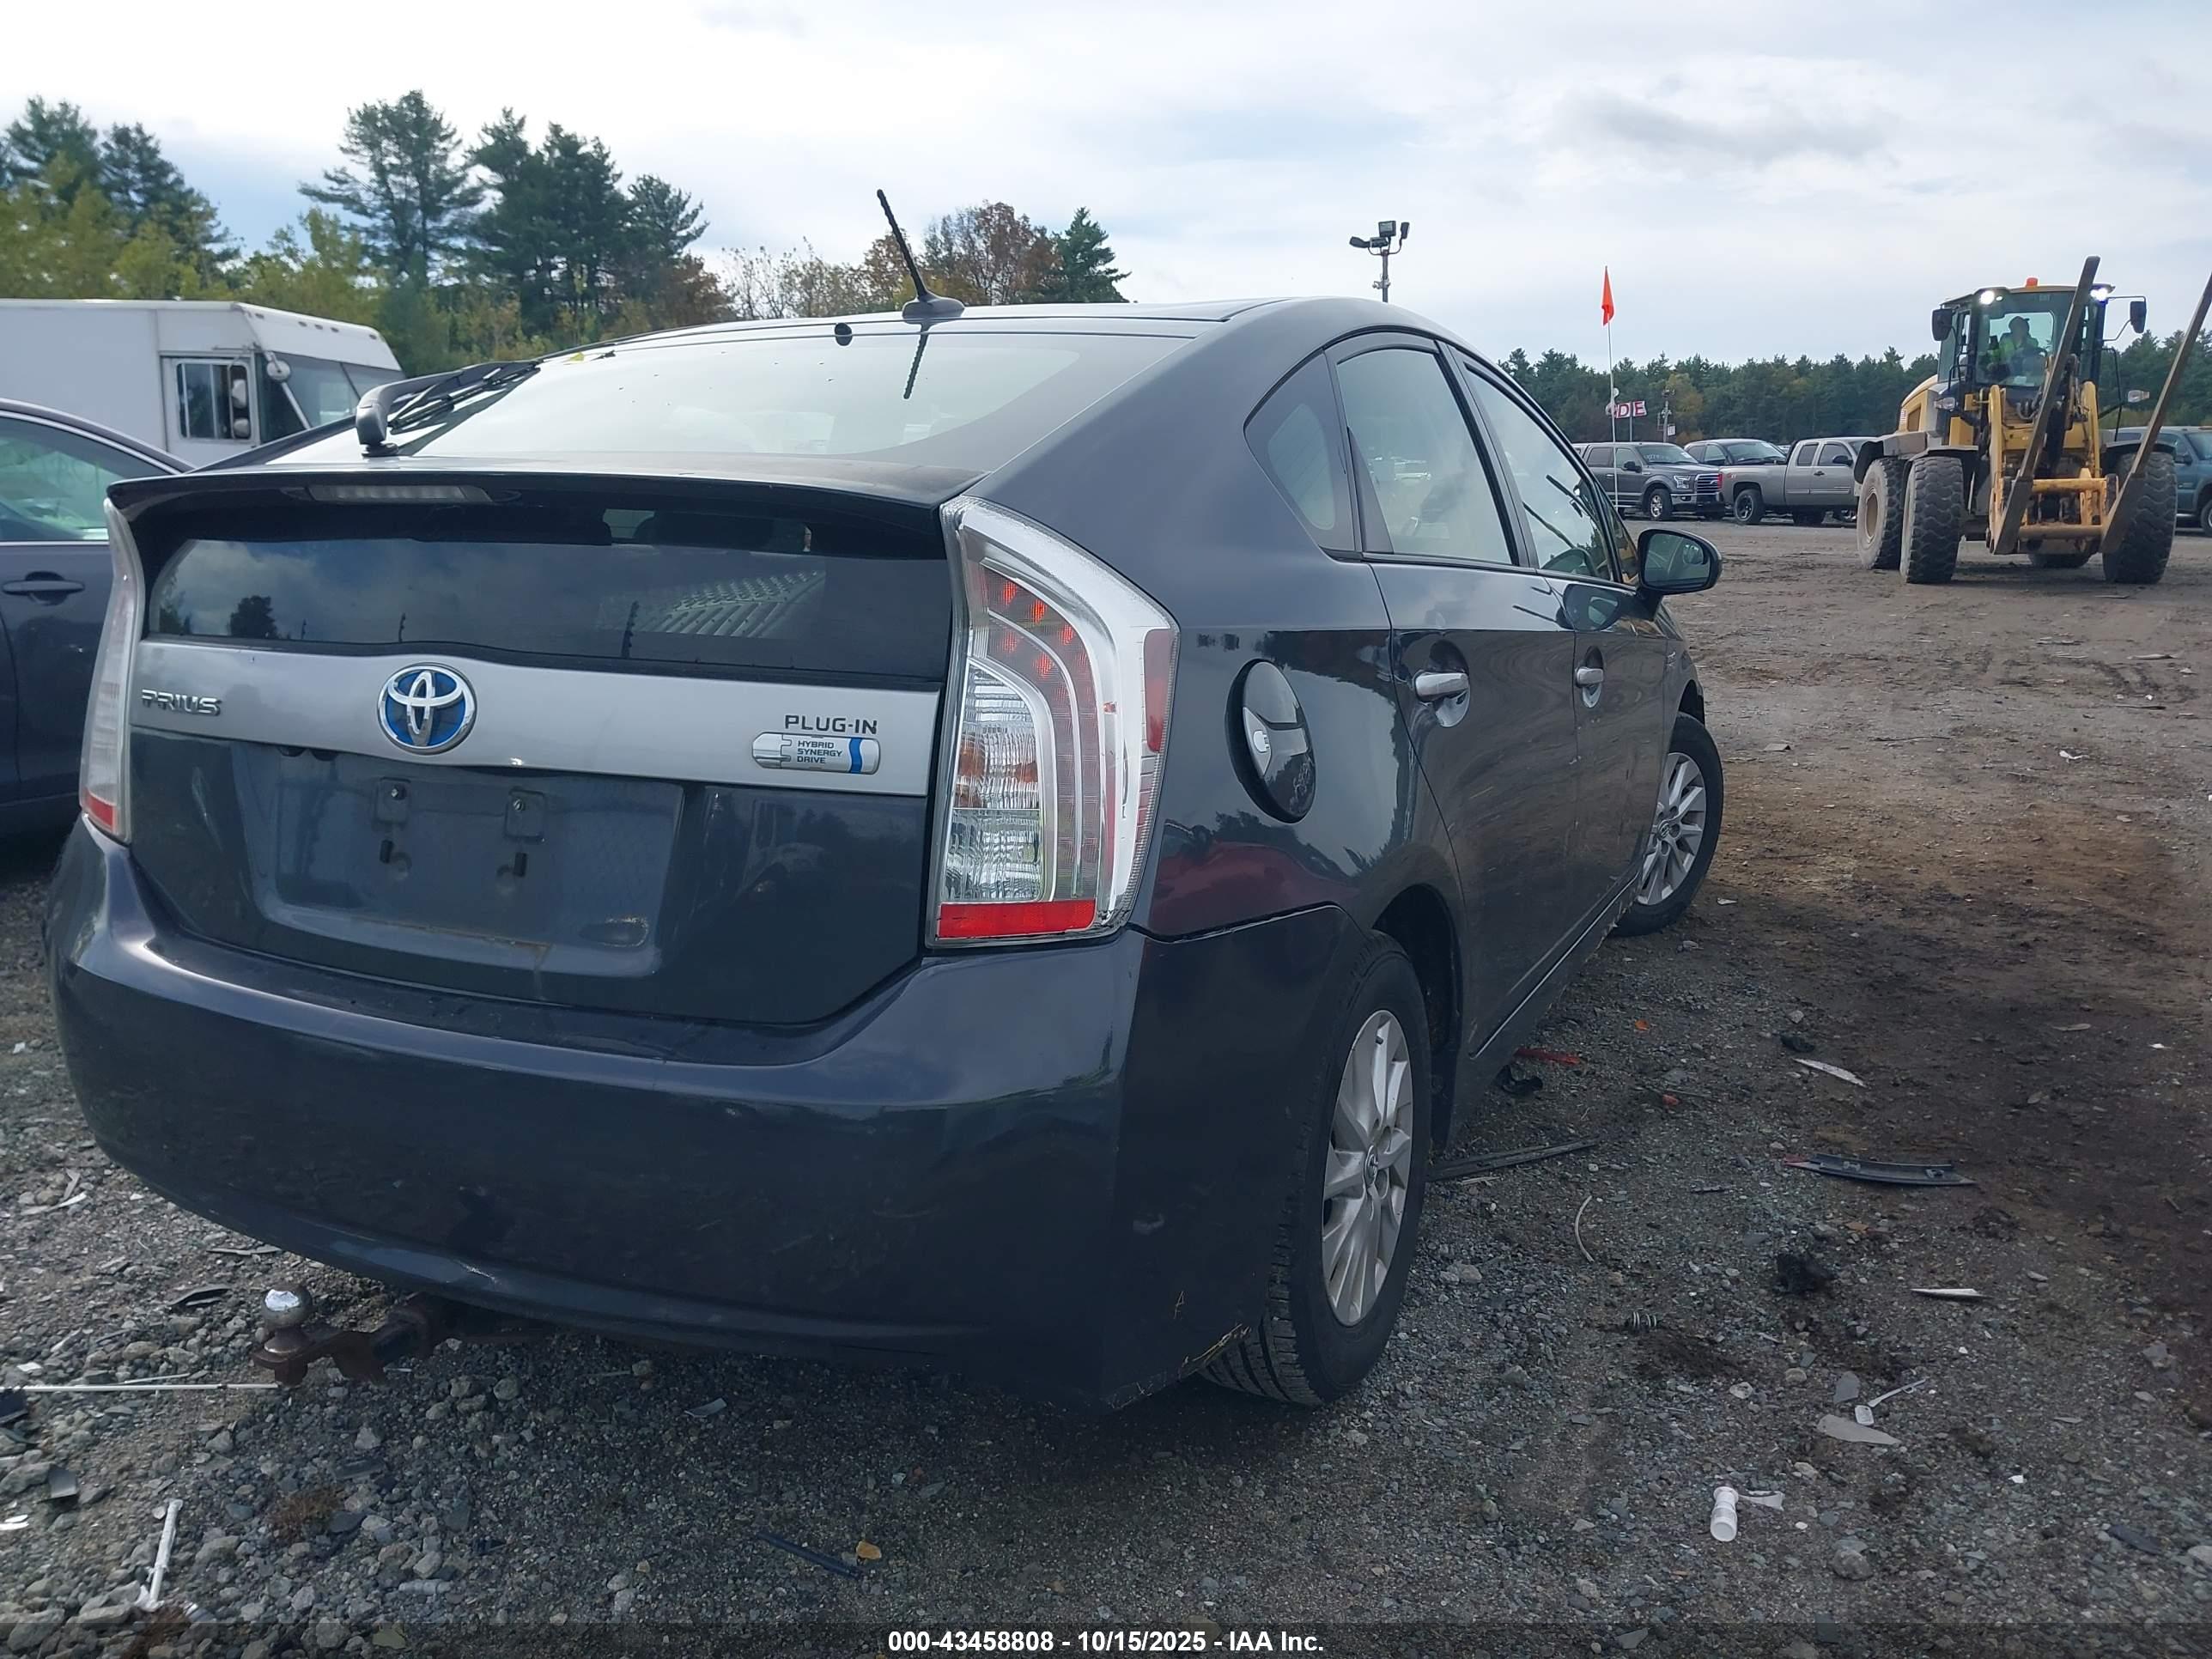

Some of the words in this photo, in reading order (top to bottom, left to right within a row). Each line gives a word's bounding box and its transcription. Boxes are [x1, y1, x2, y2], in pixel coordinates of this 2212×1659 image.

[141, 689, 222, 716] PRIUS
[785, 714, 878, 734] PLUG-IN
[798, 740, 835, 749] HYBRID
[797, 748, 842, 757] SYNERGY
[797, 756, 826, 764] DRIVE
